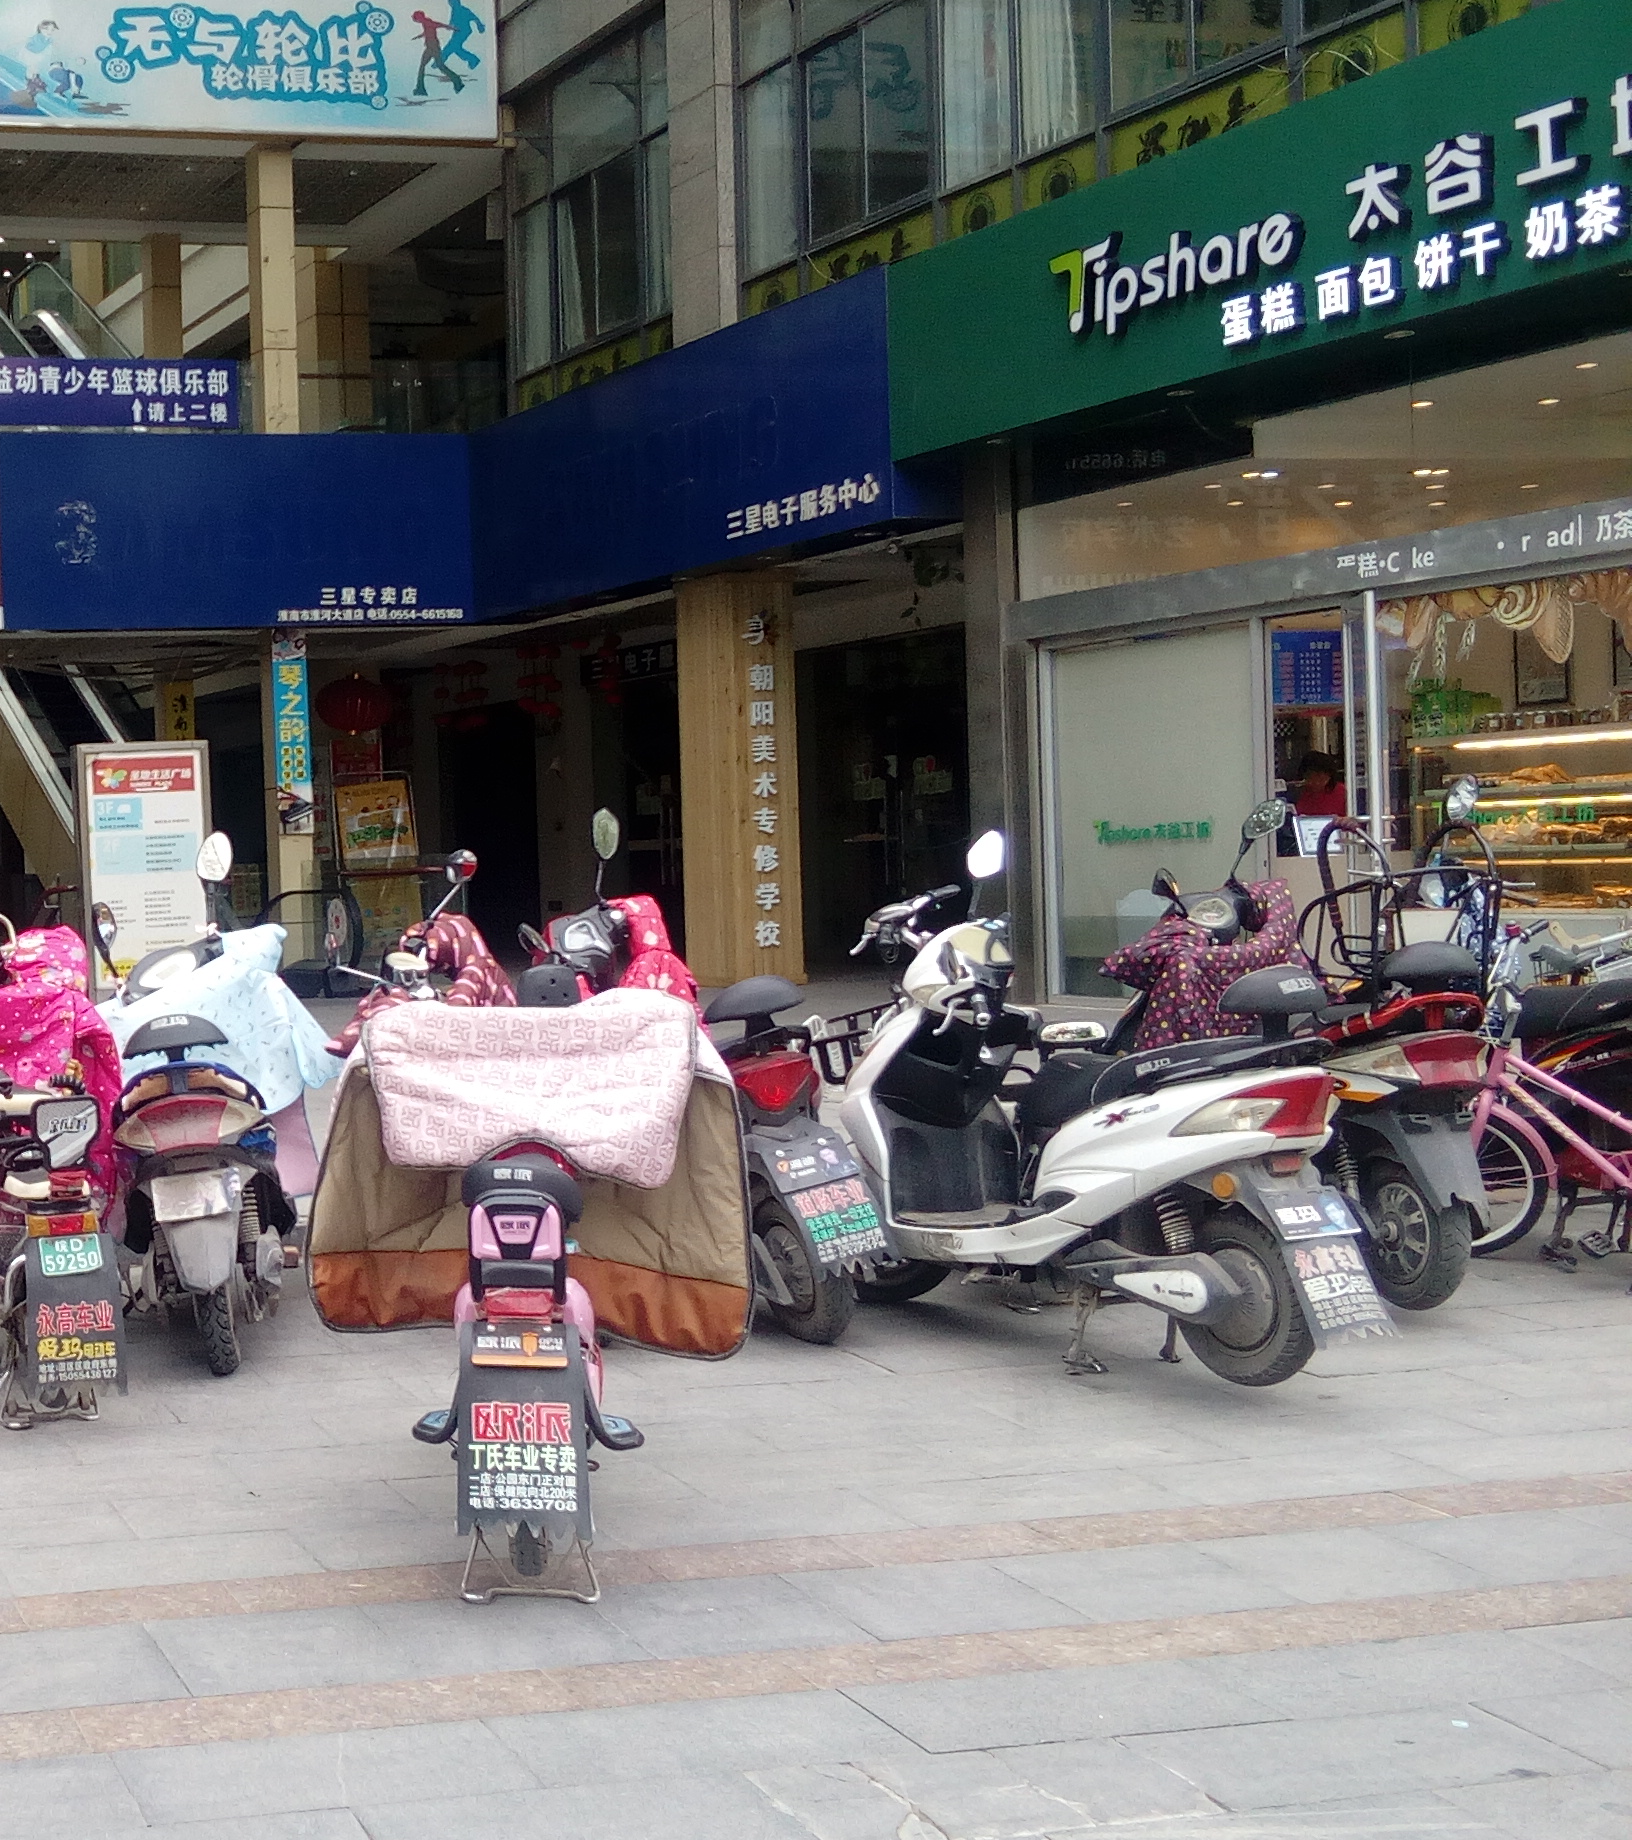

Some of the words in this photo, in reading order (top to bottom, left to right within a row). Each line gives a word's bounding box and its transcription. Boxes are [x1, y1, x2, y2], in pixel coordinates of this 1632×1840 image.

[210, 63, 380, 97] 轮滑俱乐部
[1049, 211, 1297, 335] Tipshare
[1220, 281, 1299, 347] 蛋糕
[1314, 256, 1397, 321] 面包
[1413, 221, 1502, 290] 饼干
[1525, 183, 1622, 260] 奶茶
[147, 401, 229, 424] 请上二楼
[725, 472, 882, 540] 三星电子服务中心
[319, 586, 418, 606] 三星专卖店
[748, 663, 781, 949] 朝阳美术专修学校
[44, 1251, 99, 1273] 59250
[36, 1299, 115, 1338] 永高车业
[471, 1401, 572, 1444] 欧派
[468, 1443, 577, 1473] 丁氏车业专卖
